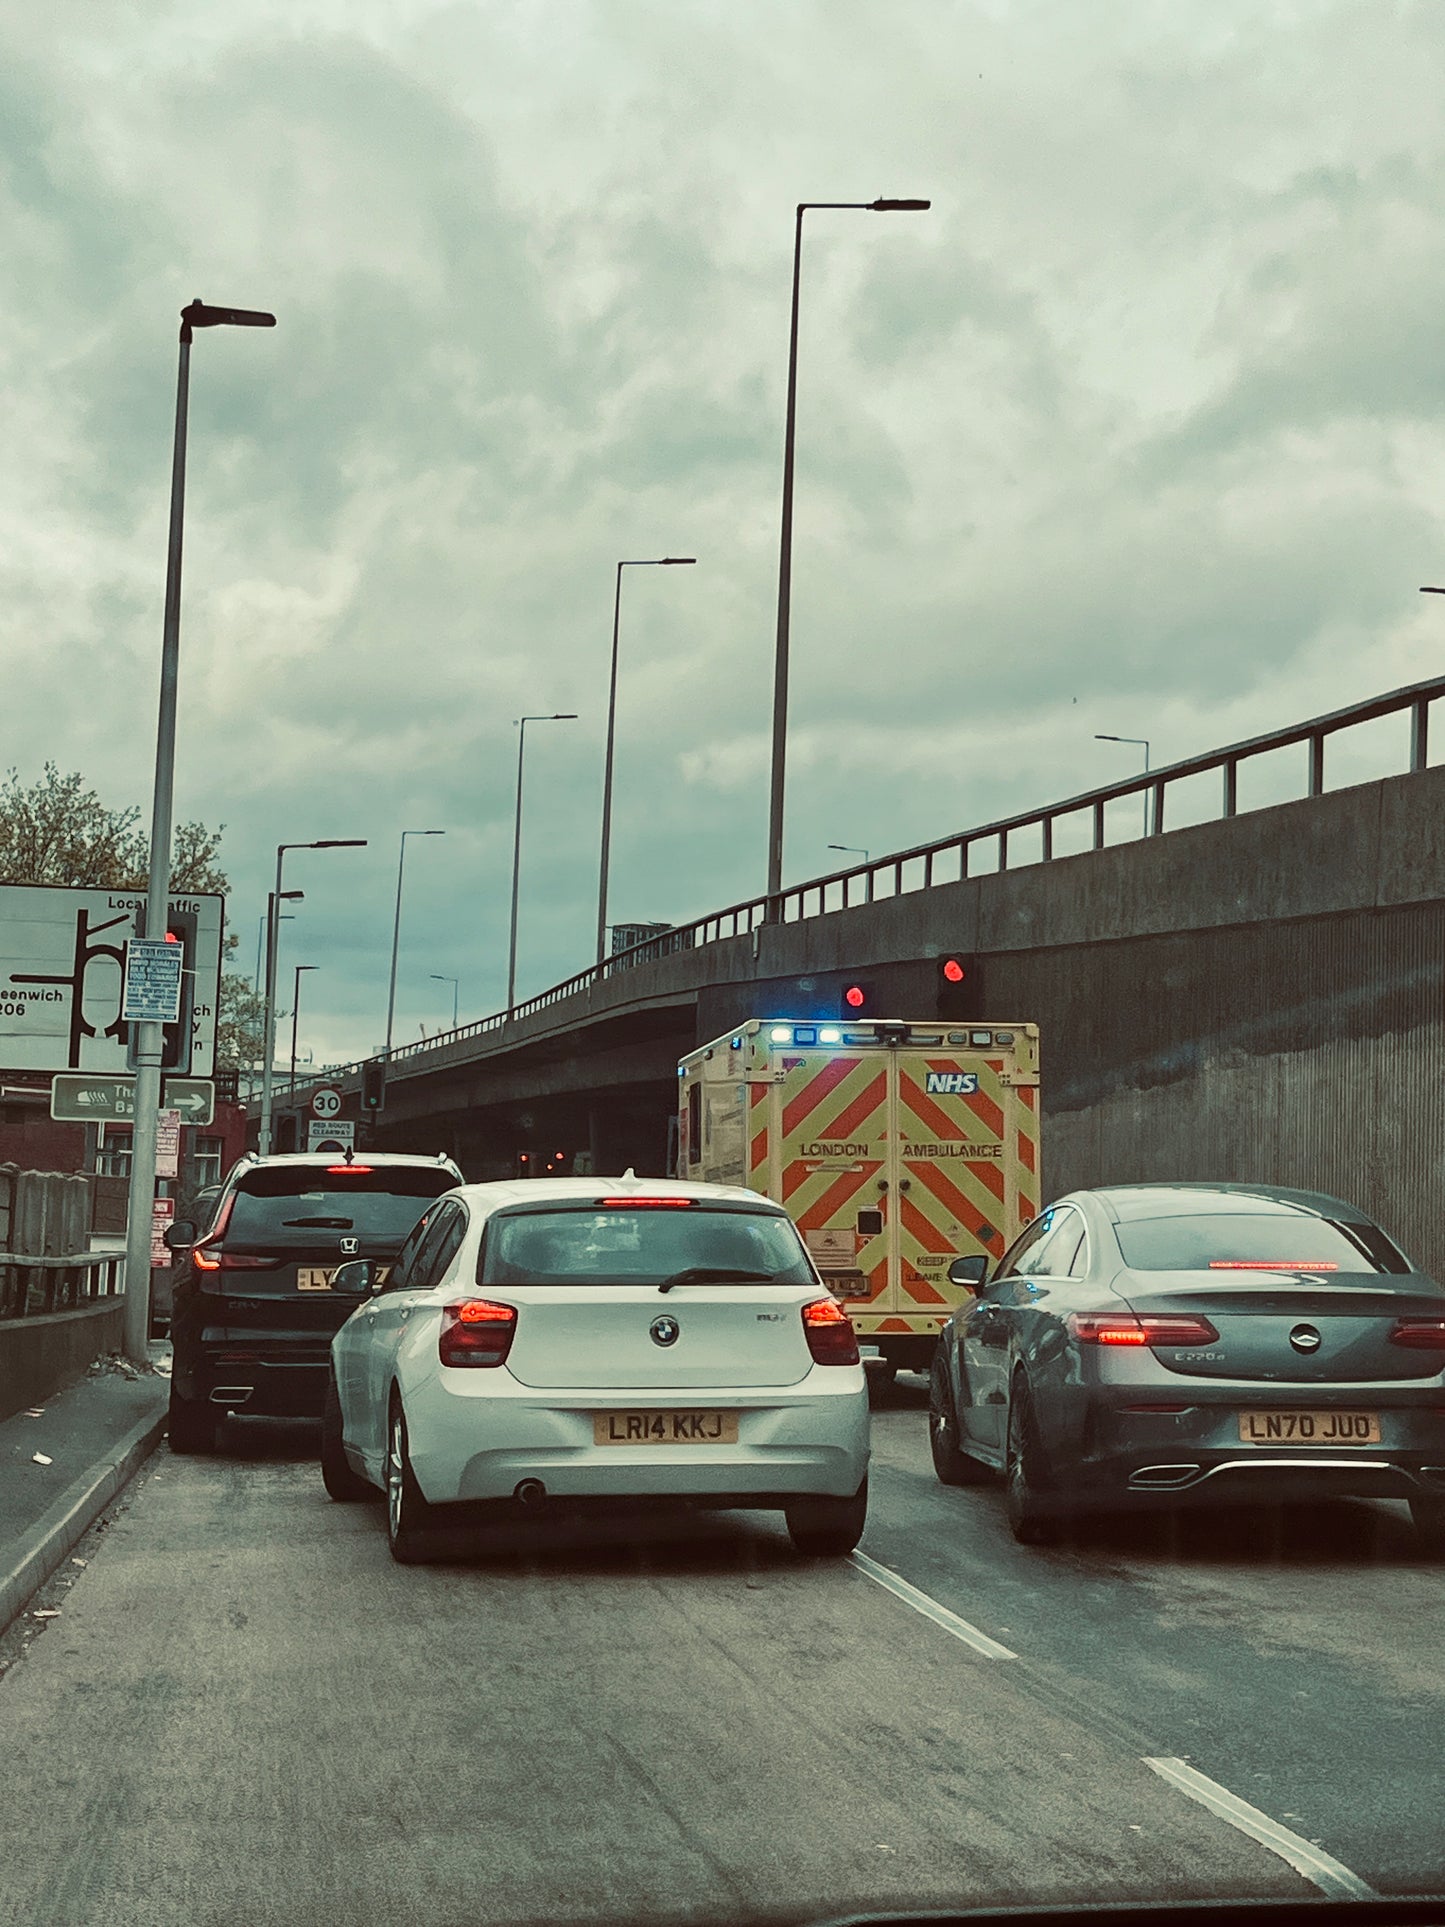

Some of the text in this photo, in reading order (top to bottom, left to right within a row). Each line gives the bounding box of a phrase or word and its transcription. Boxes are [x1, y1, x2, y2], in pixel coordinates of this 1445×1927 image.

[108, 896, 148, 910] Local
[0, 989, 63, 1002] eenwich
[927, 1074, 976, 1093] NHS
[315, 1097, 339, 1111] 30
[328, 1122, 351, 1130] ROUTE
[800, 1143, 1002, 1158] LONDON AMBULANCE
[609, 1414, 723, 1440] LR14 KKJ
[1249, 1415, 1315, 1438] LN70
